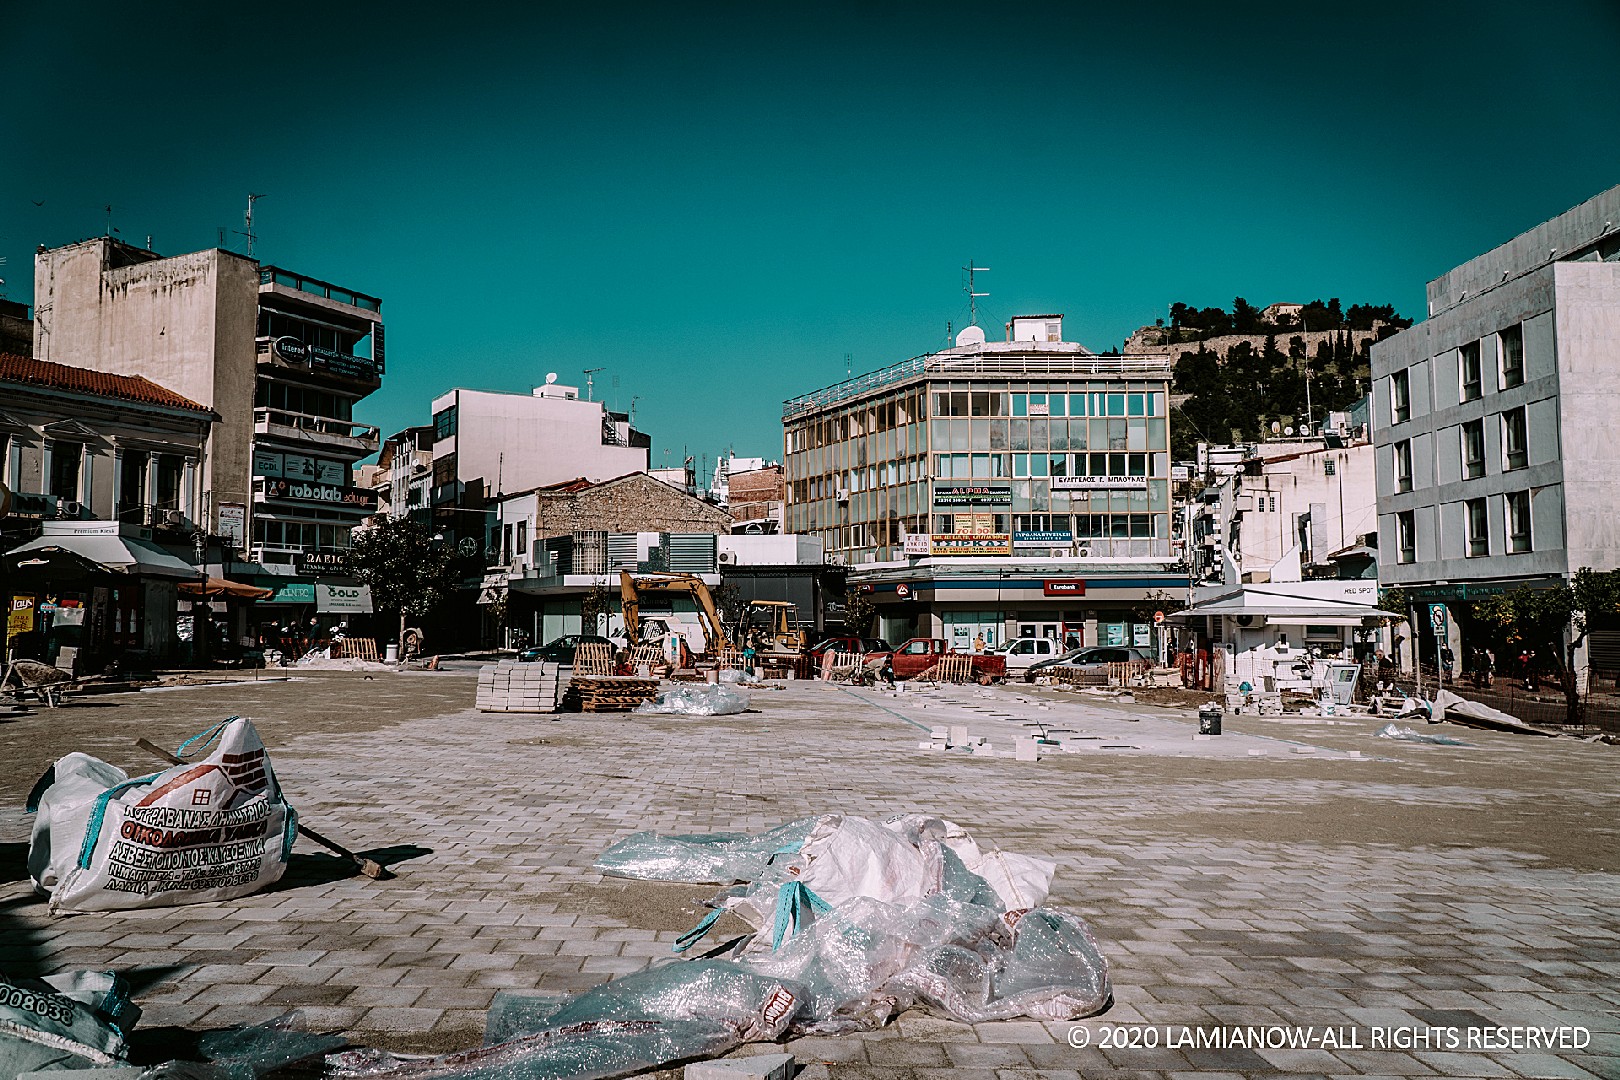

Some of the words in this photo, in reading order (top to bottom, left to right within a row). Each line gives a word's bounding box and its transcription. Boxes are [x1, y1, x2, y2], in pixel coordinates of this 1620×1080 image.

[259, 461, 278, 471] ECDL
[289, 483, 342, 502] robolab
[328, 588, 360, 598] GOLD
[210, 798, 271, 828] ΔΗΜΗΤΡΙΟΣ
[103, 879, 149, 895] ΛΑΜΙΑ
